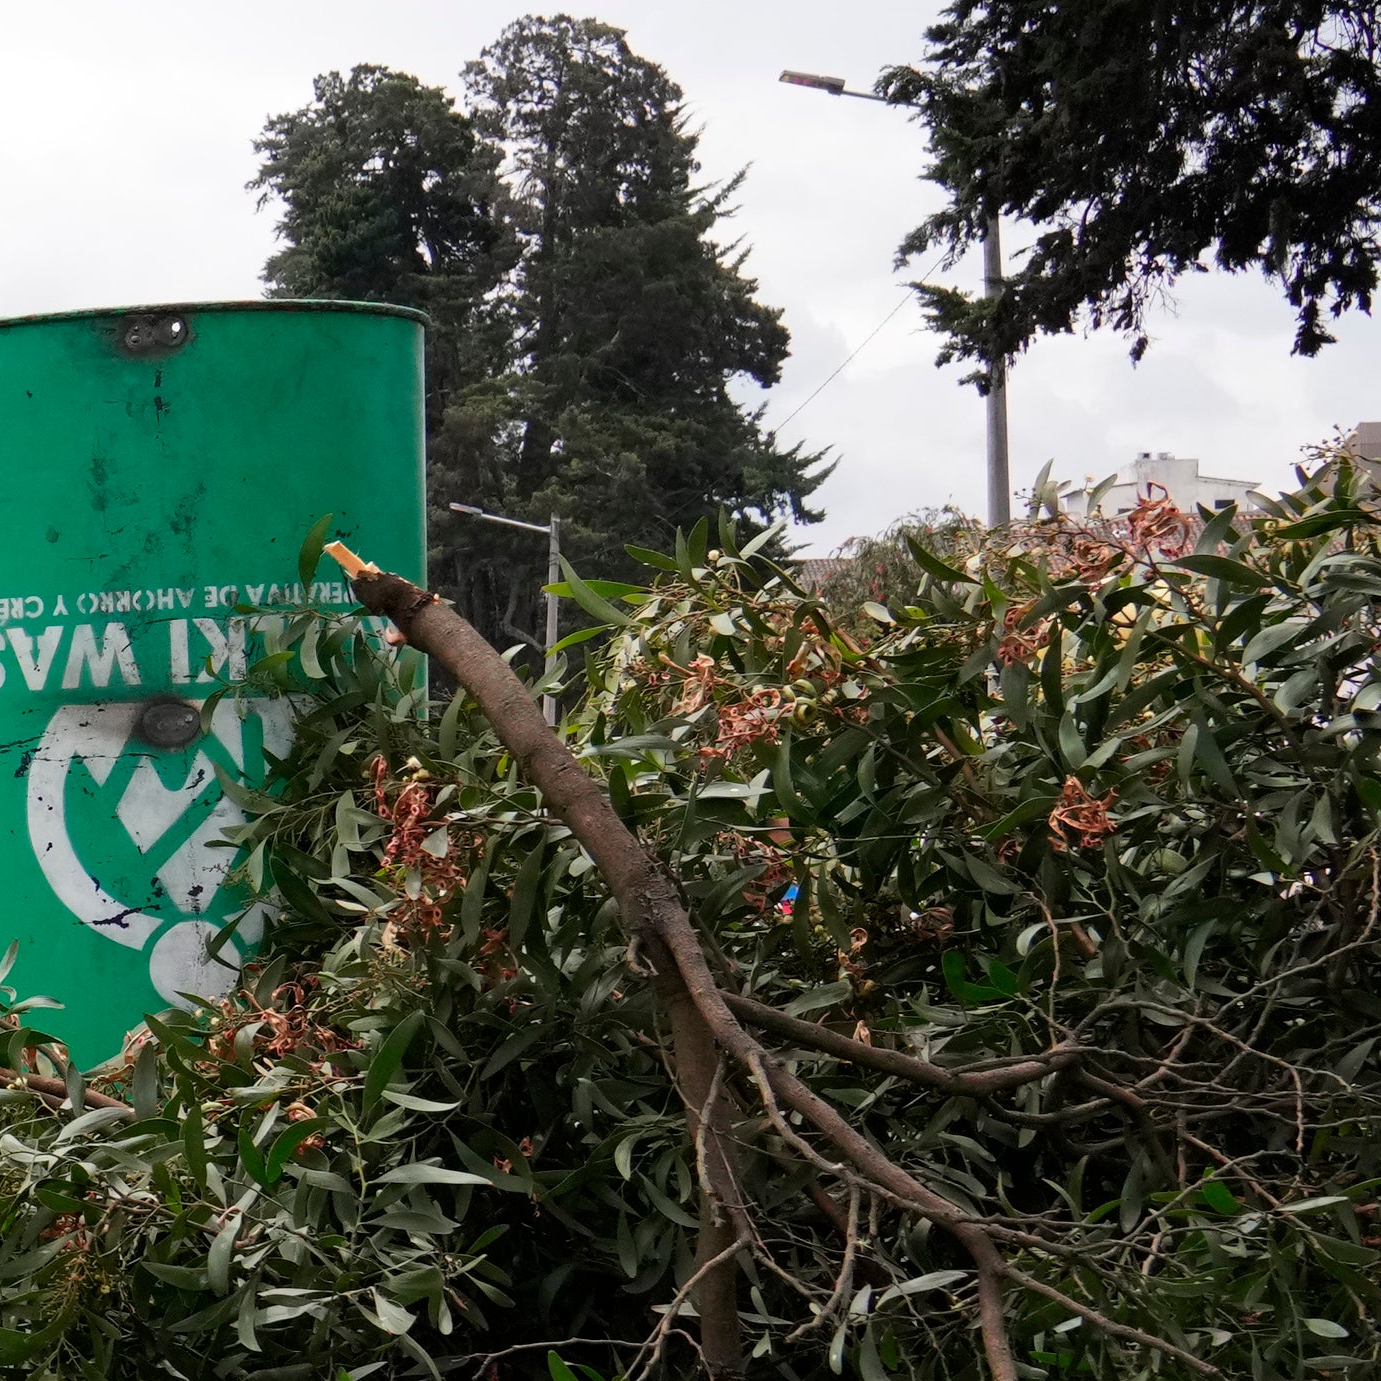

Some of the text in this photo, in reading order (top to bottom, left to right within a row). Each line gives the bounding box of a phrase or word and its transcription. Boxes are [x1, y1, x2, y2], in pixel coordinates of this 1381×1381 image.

[54, 594, 68, 616] Y
[77, 585, 195, 615] AHORRO
[205, 585, 237, 608] DE
[246, 581, 354, 606] PERATIVA
